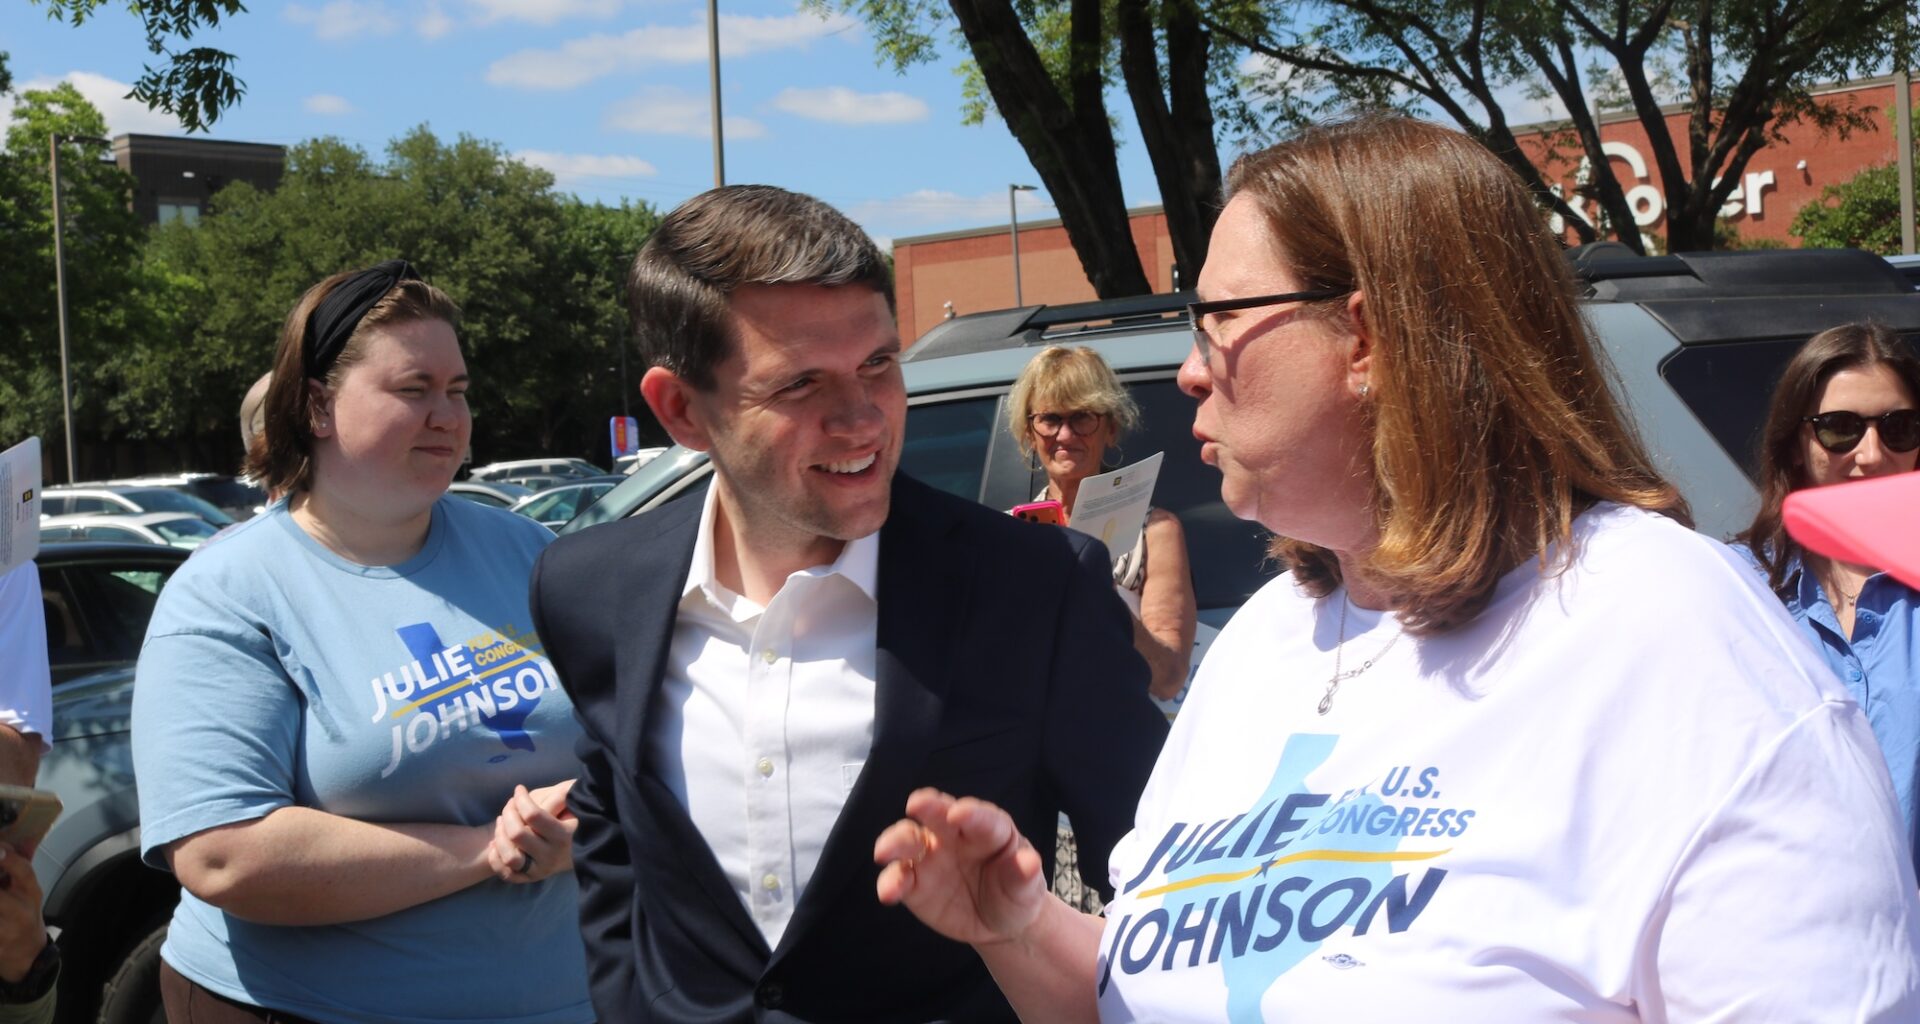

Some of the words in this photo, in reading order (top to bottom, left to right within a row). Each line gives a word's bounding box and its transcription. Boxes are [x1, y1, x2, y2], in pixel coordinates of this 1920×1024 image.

[371, 643, 473, 724] JULIE
[1380, 766, 1441, 799] U.S.
[1122, 793, 1332, 895] JULIE
[1099, 867, 1448, 998] JOHNSON
